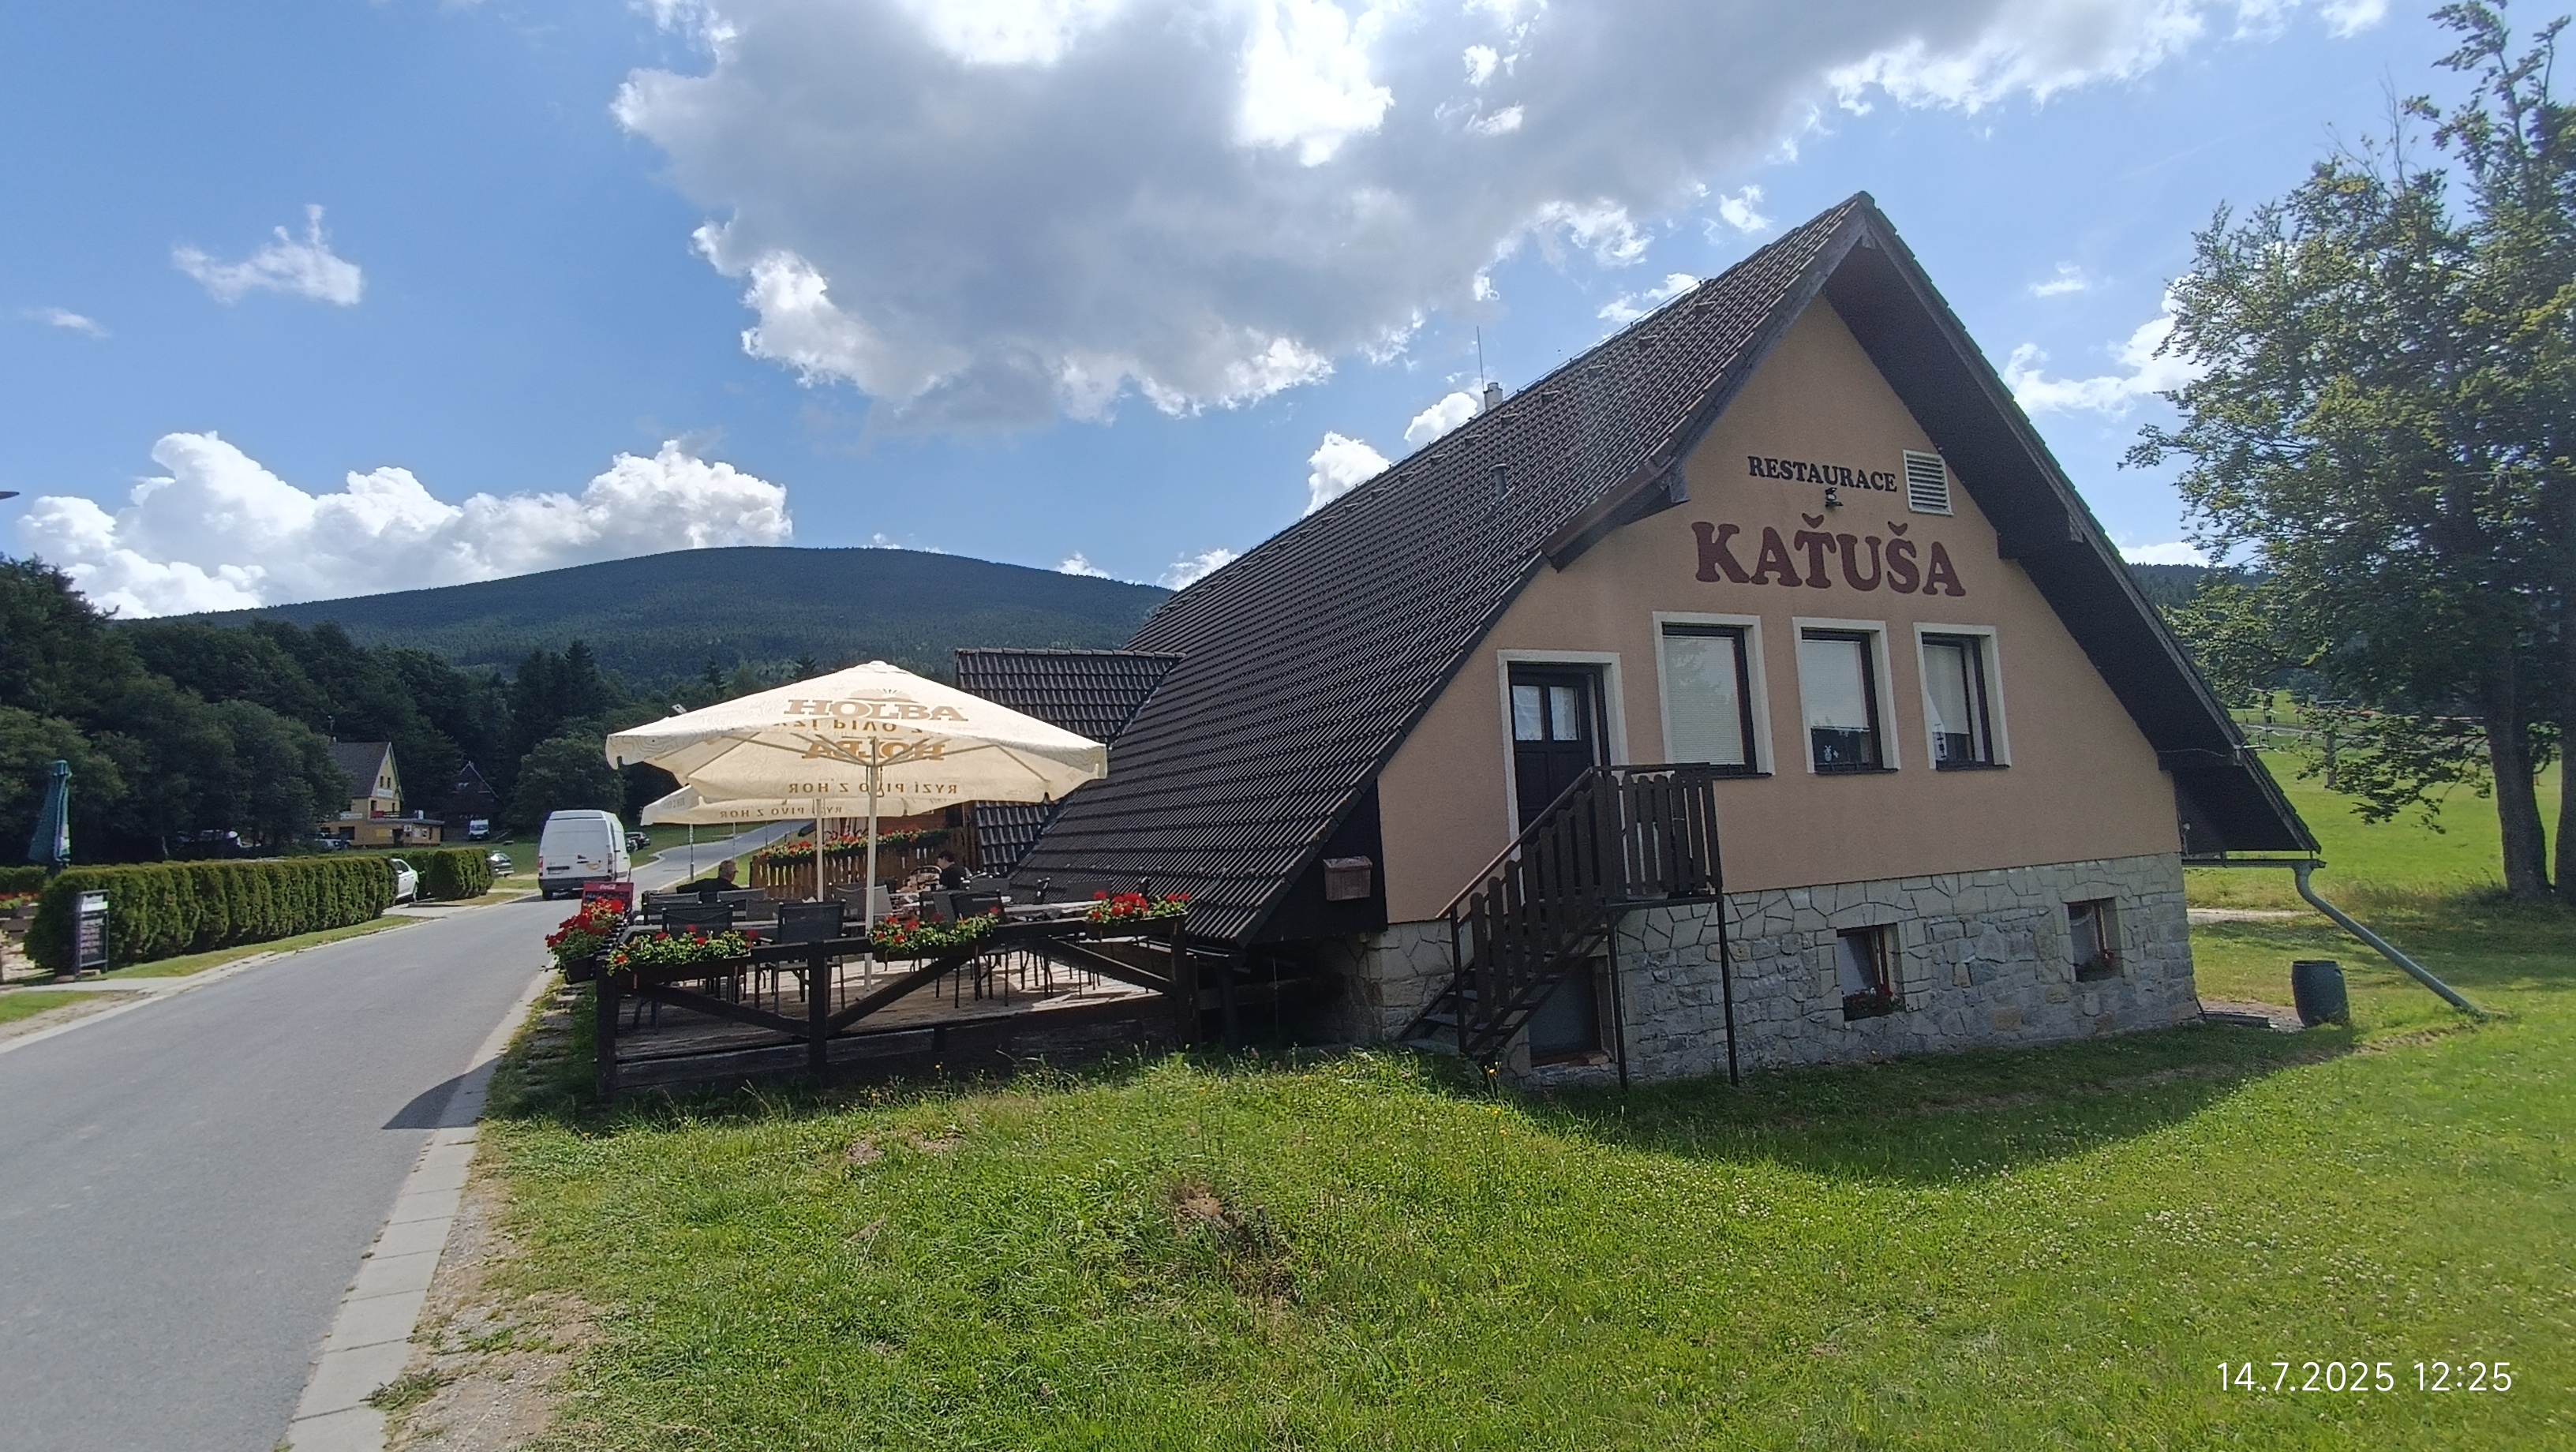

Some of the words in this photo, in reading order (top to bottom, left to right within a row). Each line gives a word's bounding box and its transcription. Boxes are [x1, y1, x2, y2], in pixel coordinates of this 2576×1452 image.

[1747, 455, 1897, 492] RESTAURACE
[1691, 513, 1966, 597] KAŤUŠA
[784, 699, 968, 721] HOLBA
